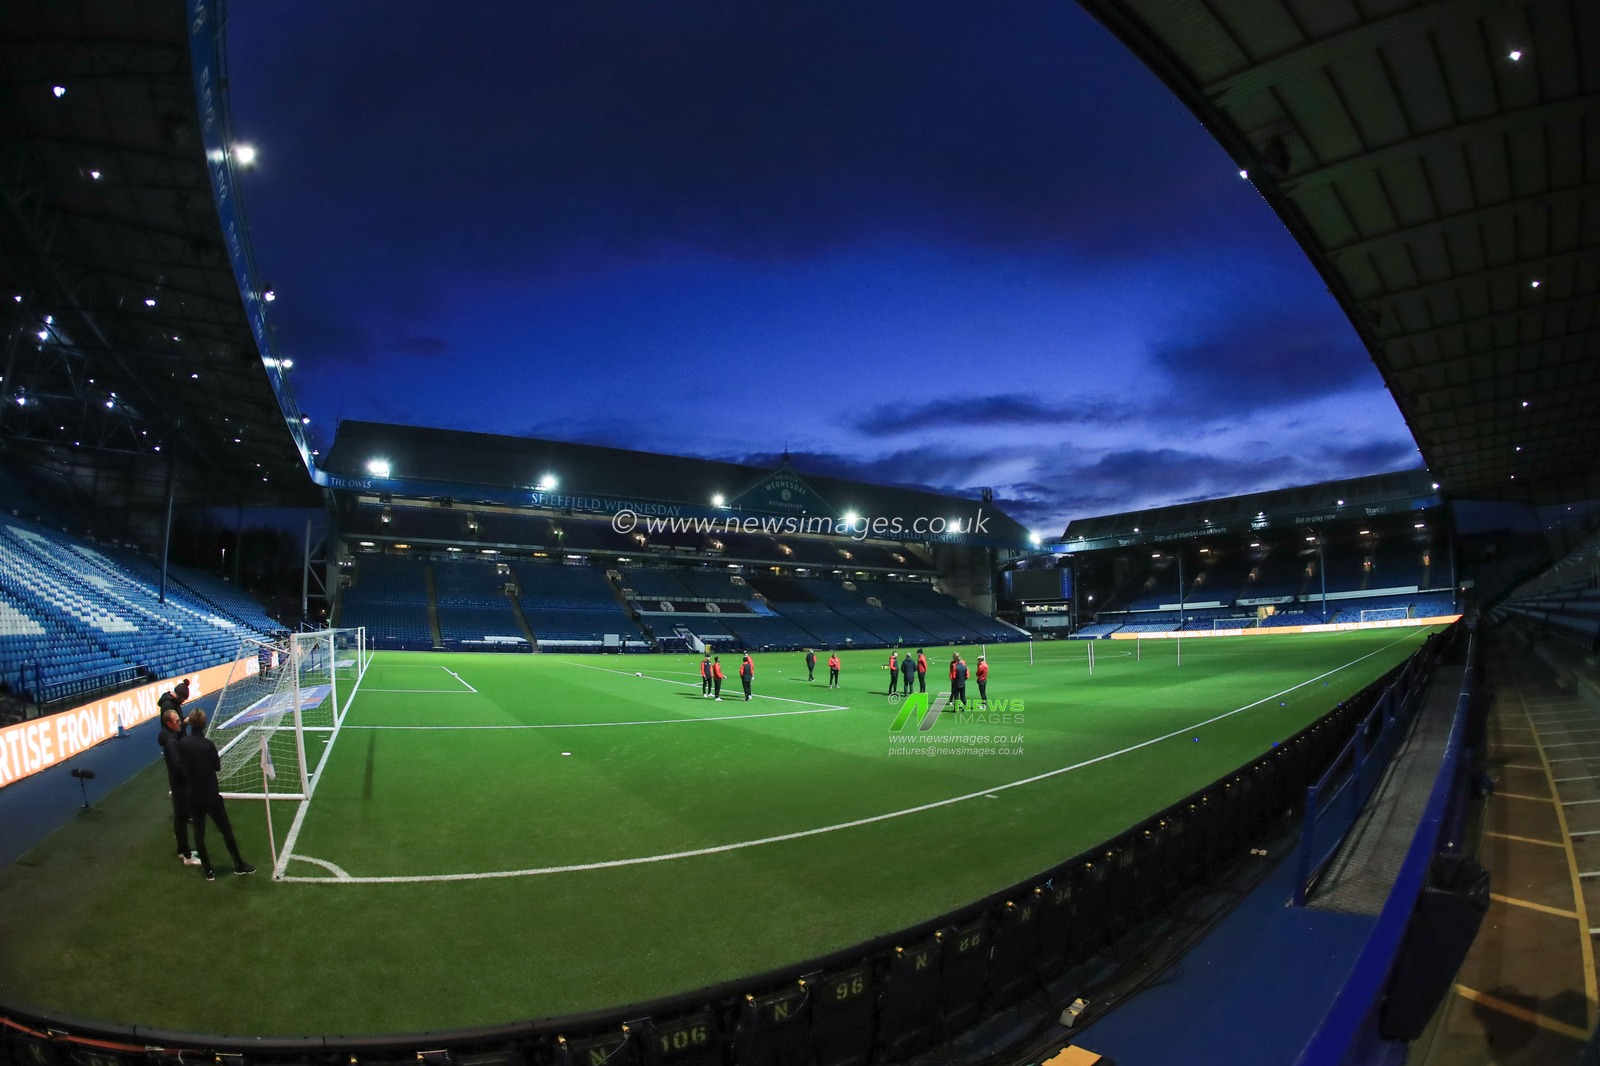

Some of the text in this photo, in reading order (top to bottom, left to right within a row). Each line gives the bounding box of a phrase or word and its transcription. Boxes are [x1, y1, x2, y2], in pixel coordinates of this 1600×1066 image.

[330, 477, 371, 489] THE OWLS
[765, 481, 806, 495] WEDNESDAY
[531, 492, 682, 517] SHEFFIELD WEDNESDAY
[1295, 516, 1305, 524] Bet
[1324, 513, 1337, 521] now
[56, 704, 105, 758] FROM
[915, 952, 928, 971] N
[835, 976, 864, 1001] 96
[774, 1001, 791, 1022] N
[659, 1026, 707, 1054] 106
